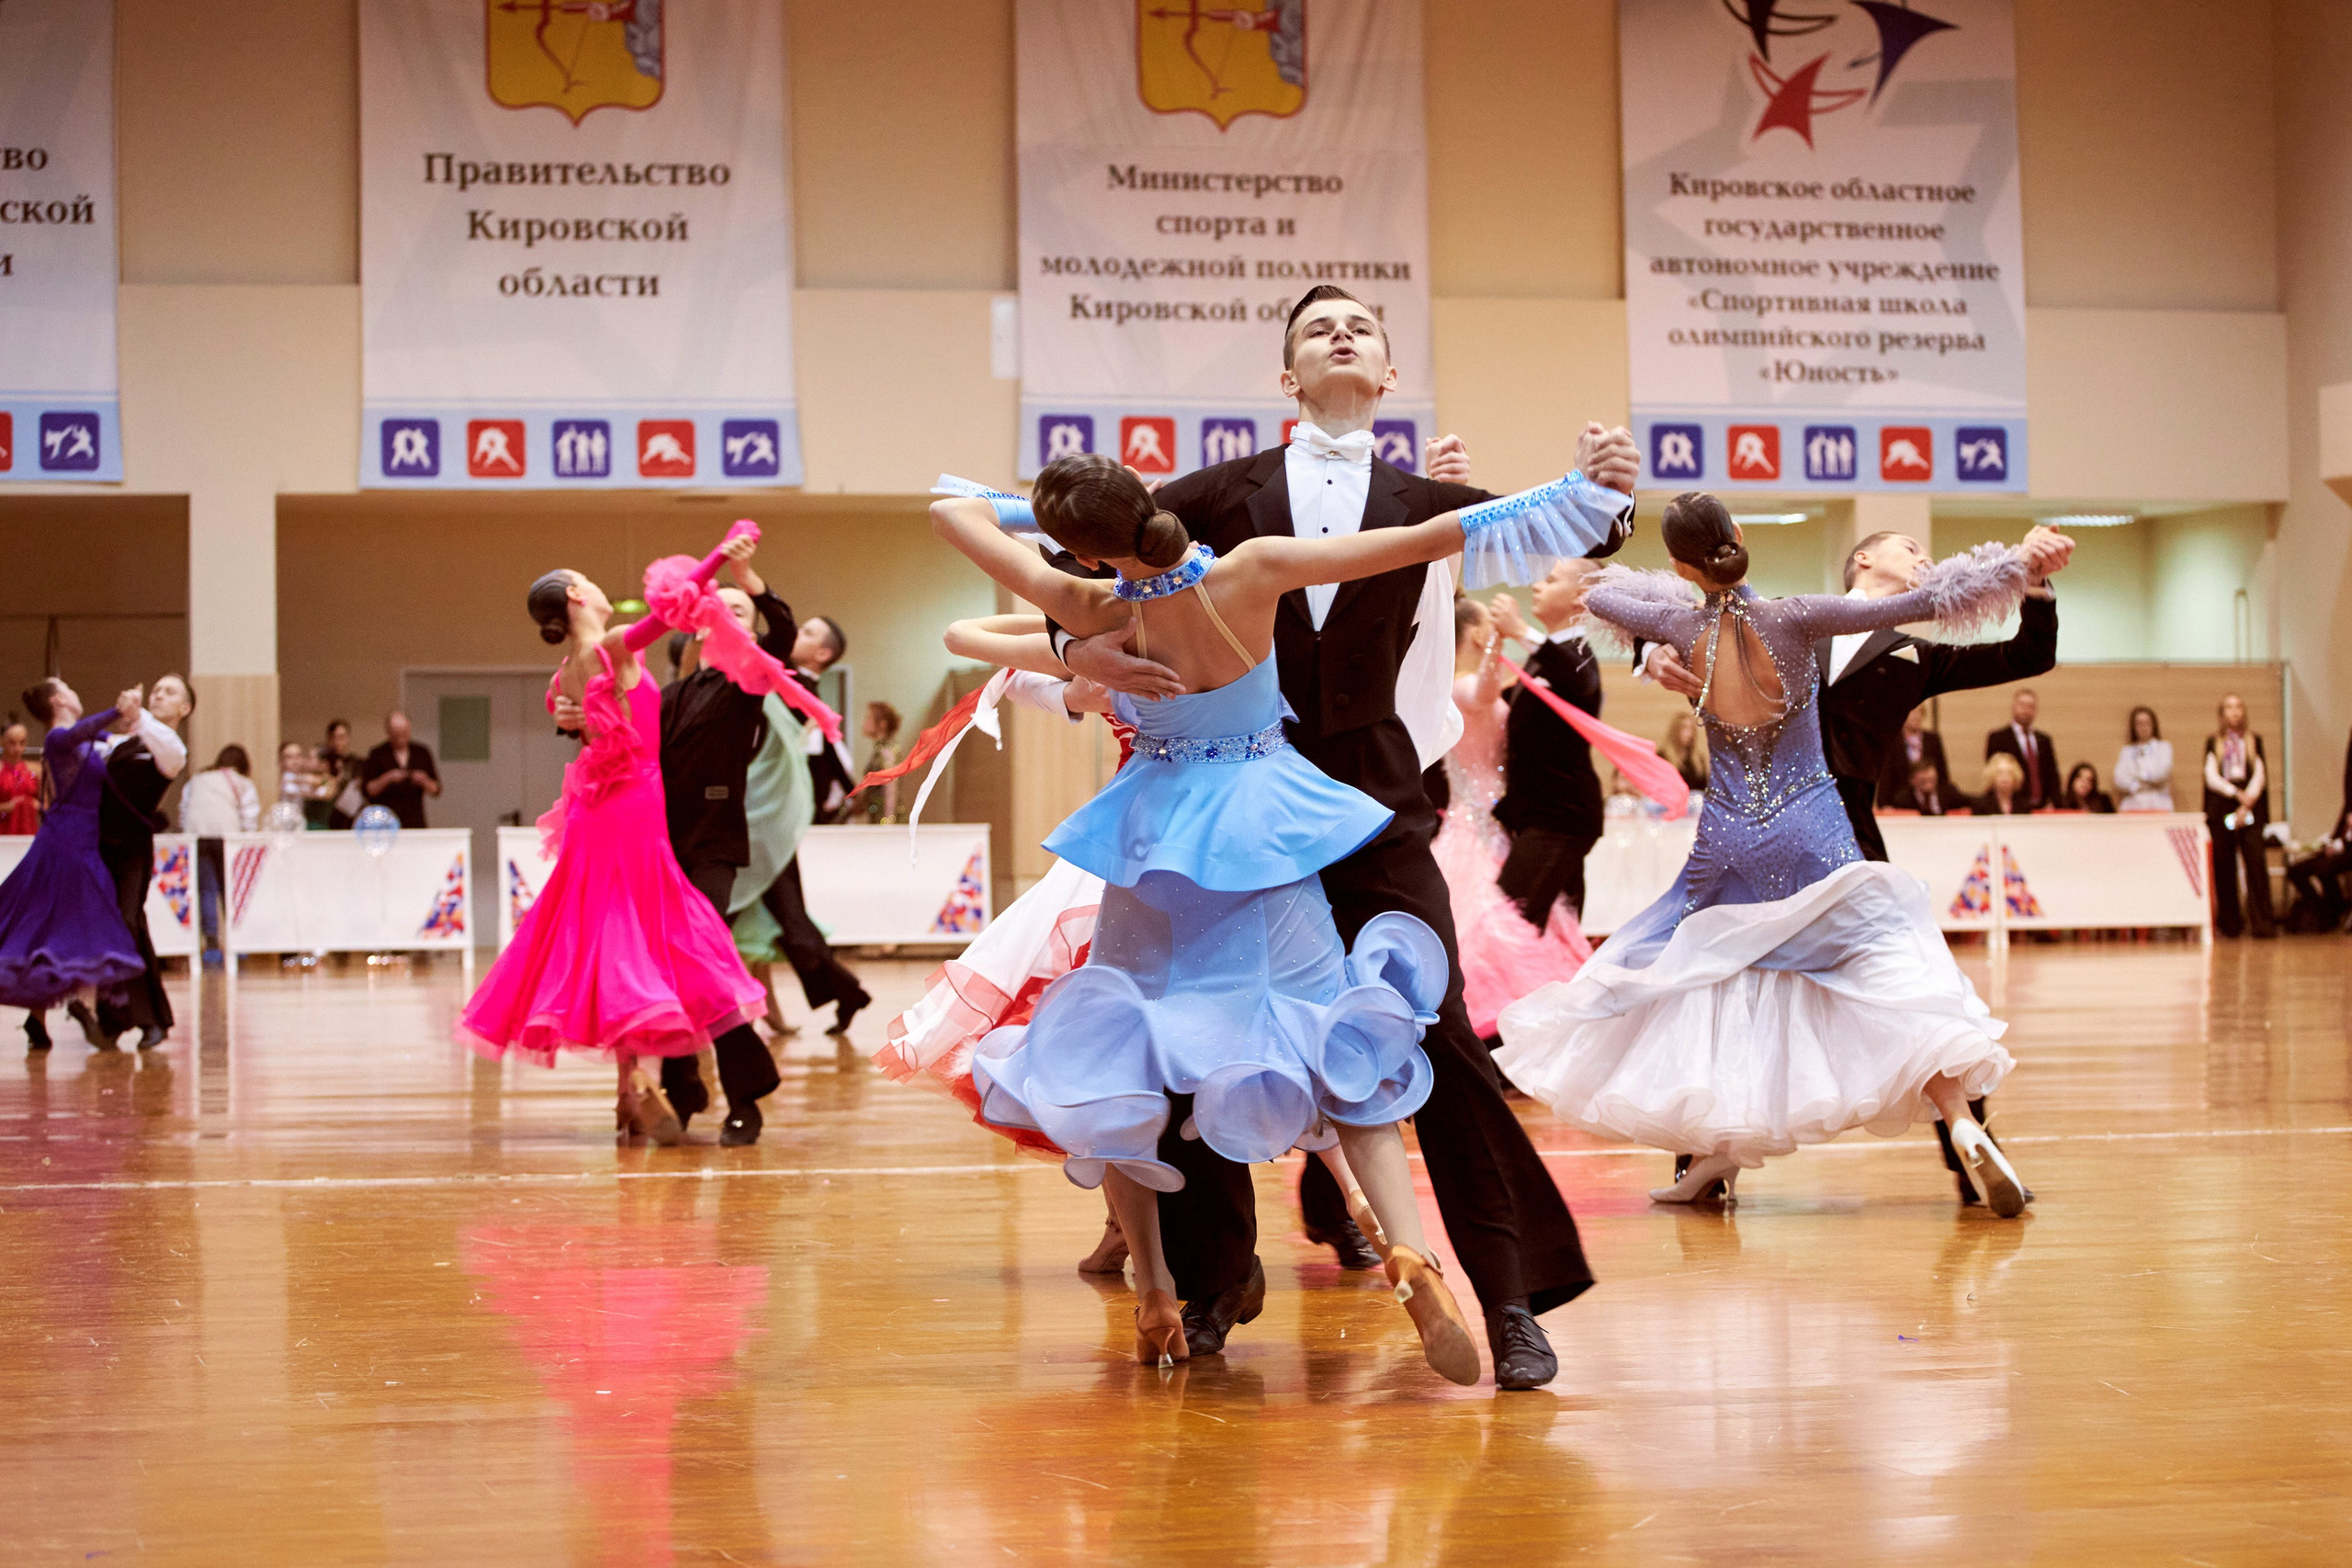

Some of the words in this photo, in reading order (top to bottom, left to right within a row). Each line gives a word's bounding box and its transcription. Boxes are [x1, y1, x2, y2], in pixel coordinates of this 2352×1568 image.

[0, 148, 48, 170] во
[424, 152, 730, 191] Правительство
[1108, 164, 1343, 198] Министерство
[1669, 172, 1824, 202] Кировское
[1830, 177, 1976, 204] областное
[0, 195, 94, 224] ской
[468, 209, 688, 247] Кировской
[1156, 215, 1267, 241] спорта
[1276, 217, 1295, 237] и
[1704, 218, 1946, 244] государственное
[498, 267, 659, 297] области
[1041, 255, 1246, 280] молодежной
[1256, 261, 1410, 281] политики
[1650, 256, 1820, 277] автономное
[1828, 261, 1999, 284] учреждение
[1070, 294, 1247, 325] Кировской
[1687, 288, 1871, 318] «Спортивная
[1879, 297, 1967, 316] школа
[1668, 326, 1871, 350] олимпийского
[1878, 332, 1985, 355] резерва
[1758, 359, 1899, 384] «Юность»
